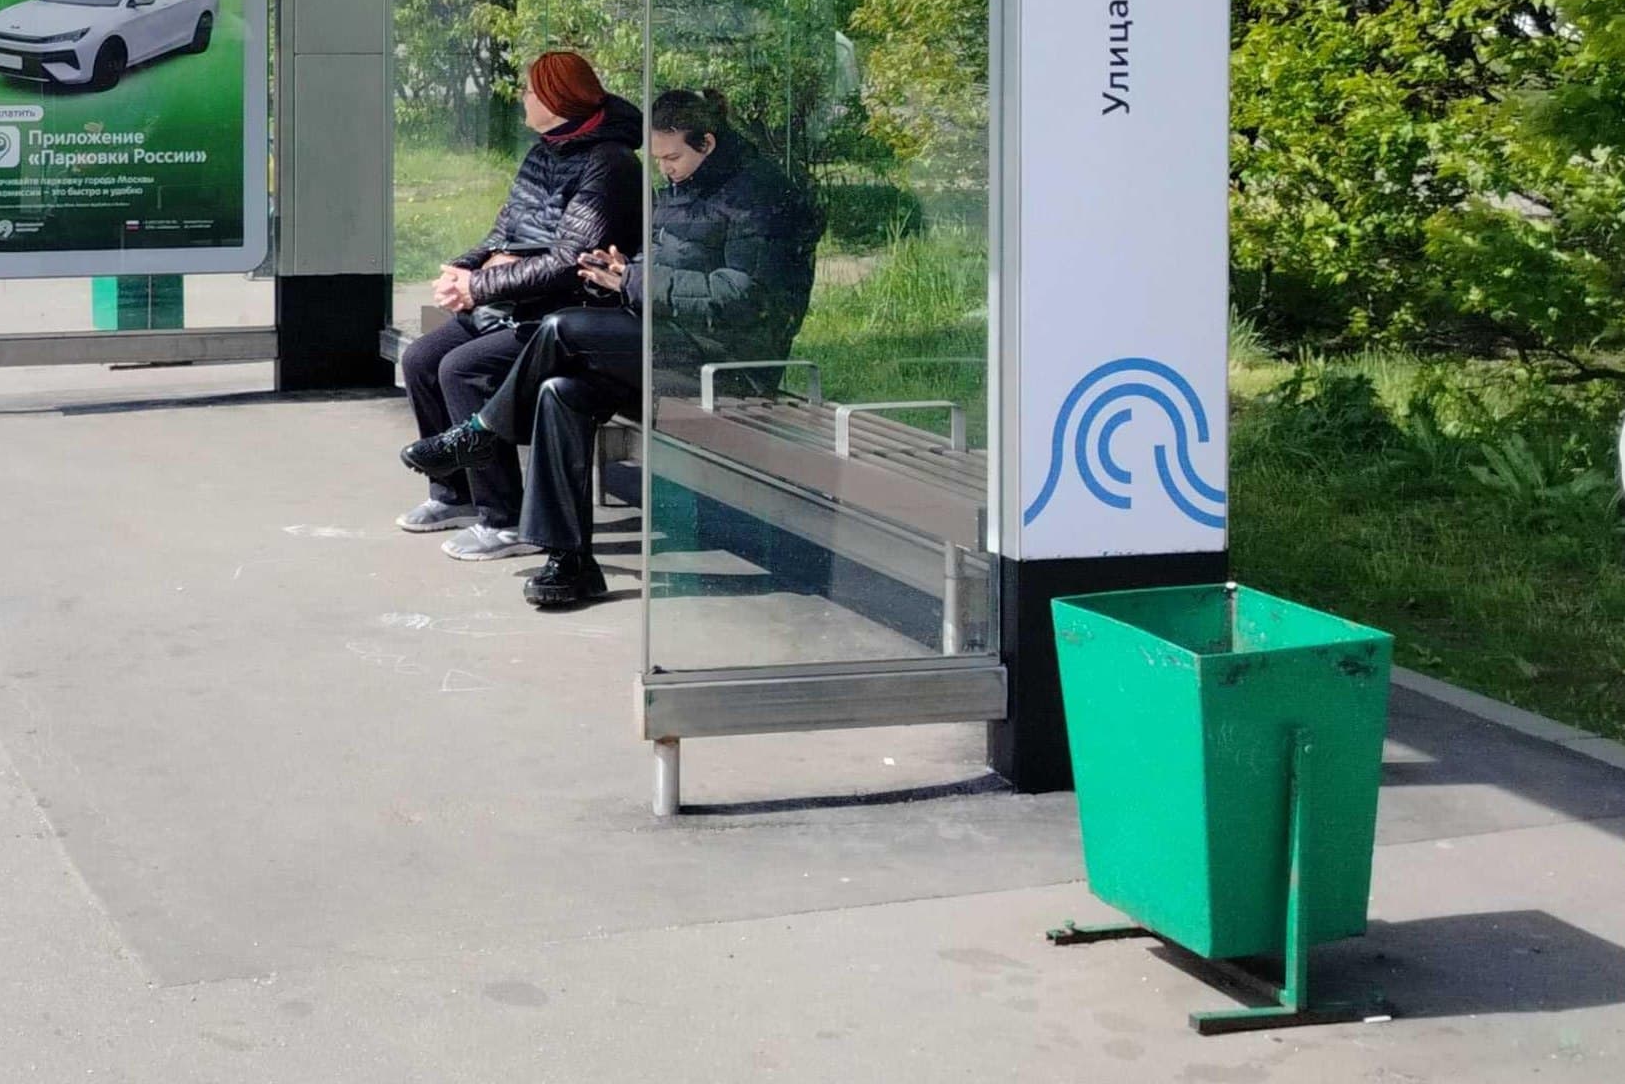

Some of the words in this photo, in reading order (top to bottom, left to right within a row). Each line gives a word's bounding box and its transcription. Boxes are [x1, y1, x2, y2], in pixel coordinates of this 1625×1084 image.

[1102, 0, 1133, 115] Улица
[28, 130, 145, 148] Приложение
[28, 150, 129, 167] «Парковки
[134, 149, 207, 164] России»
[117, 176, 155, 185] Москвы
